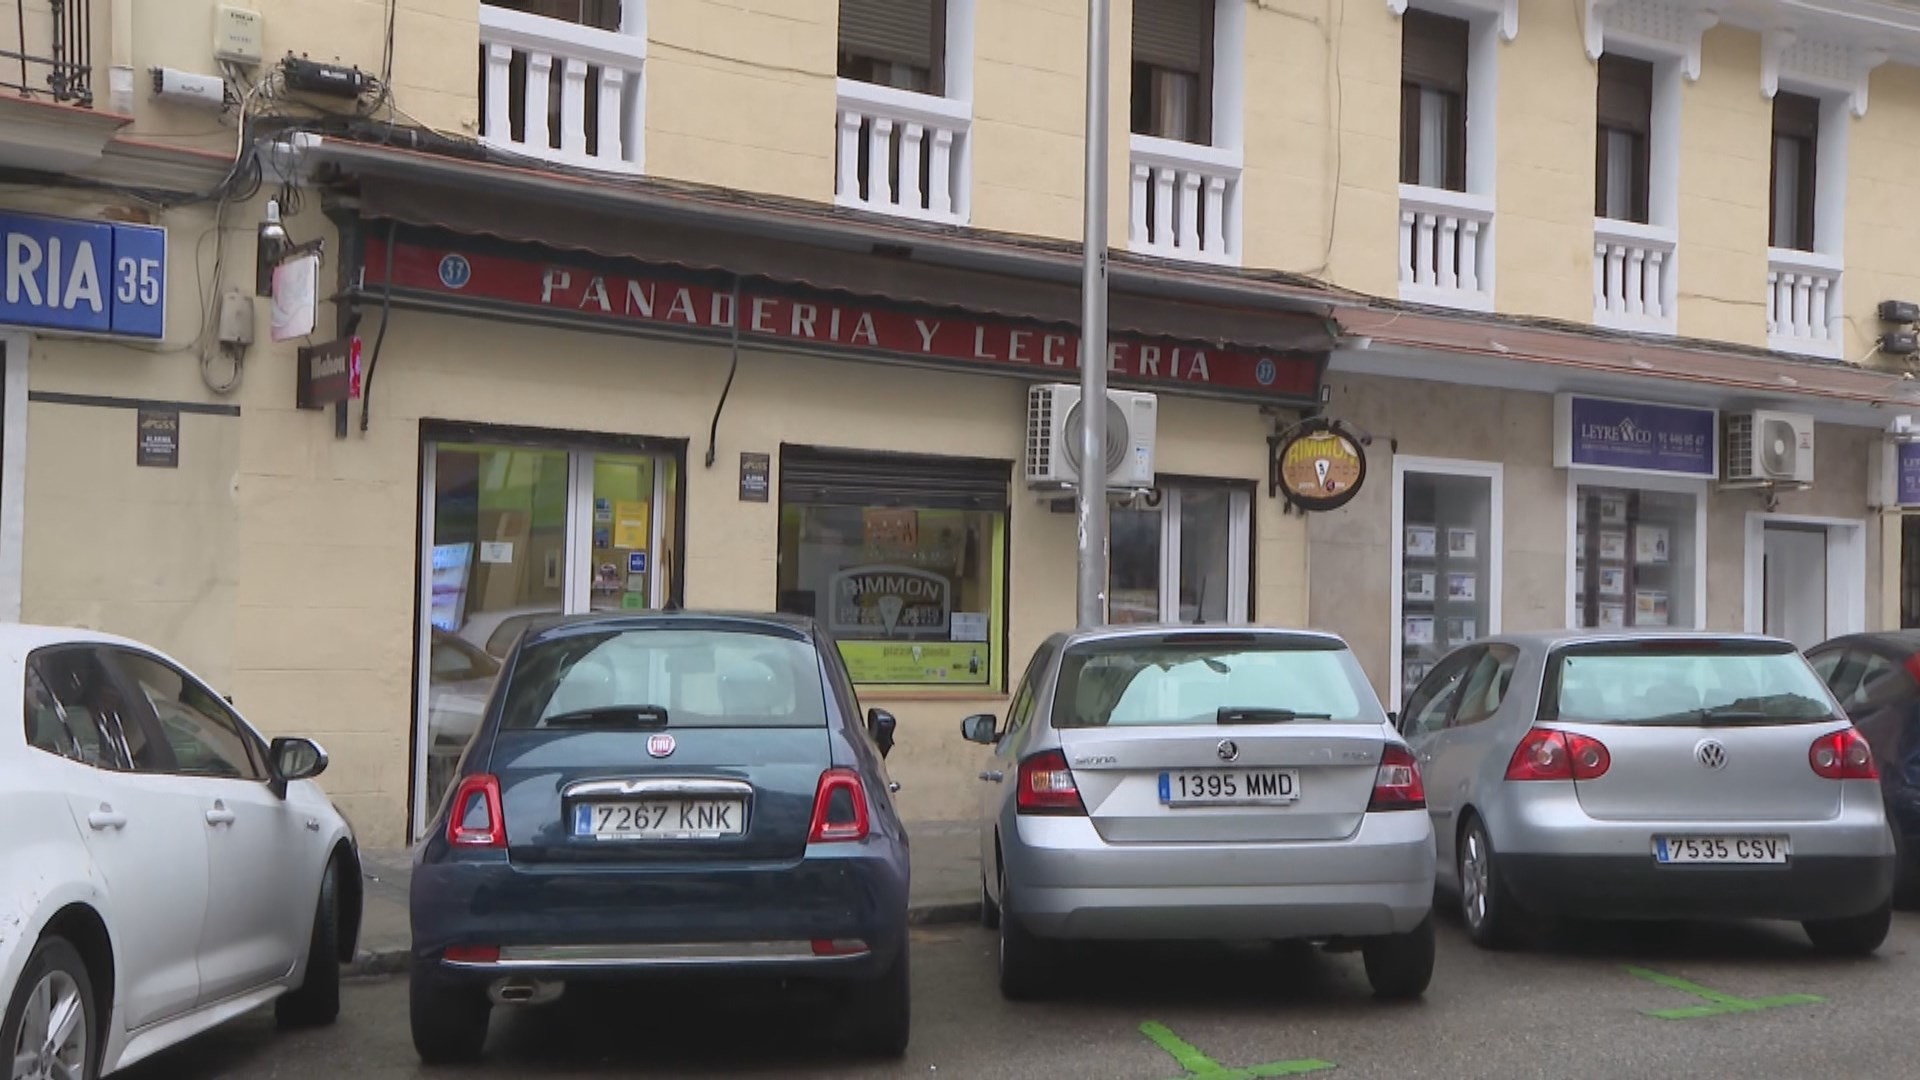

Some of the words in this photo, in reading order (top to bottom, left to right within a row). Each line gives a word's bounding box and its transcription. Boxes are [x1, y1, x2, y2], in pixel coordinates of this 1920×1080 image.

[117, 257, 159, 305] 35
[444, 259, 466, 284] 37
[541, 269, 879, 346] PANADERIA
[915, 319, 940, 352] Y
[974, 326, 1210, 381] LECERIA
[1581, 423, 1619, 442] LEYRE
[841, 575, 939, 600] RIMMON
[1179, 774, 1237, 797] 1395
[1246, 774, 1292, 795] MMD
[598, 806, 668, 831] 7267
[680, 804, 731, 829] KNK
[1671, 840, 1728, 859] 7535
[1736, 840, 1776, 859] CSV
